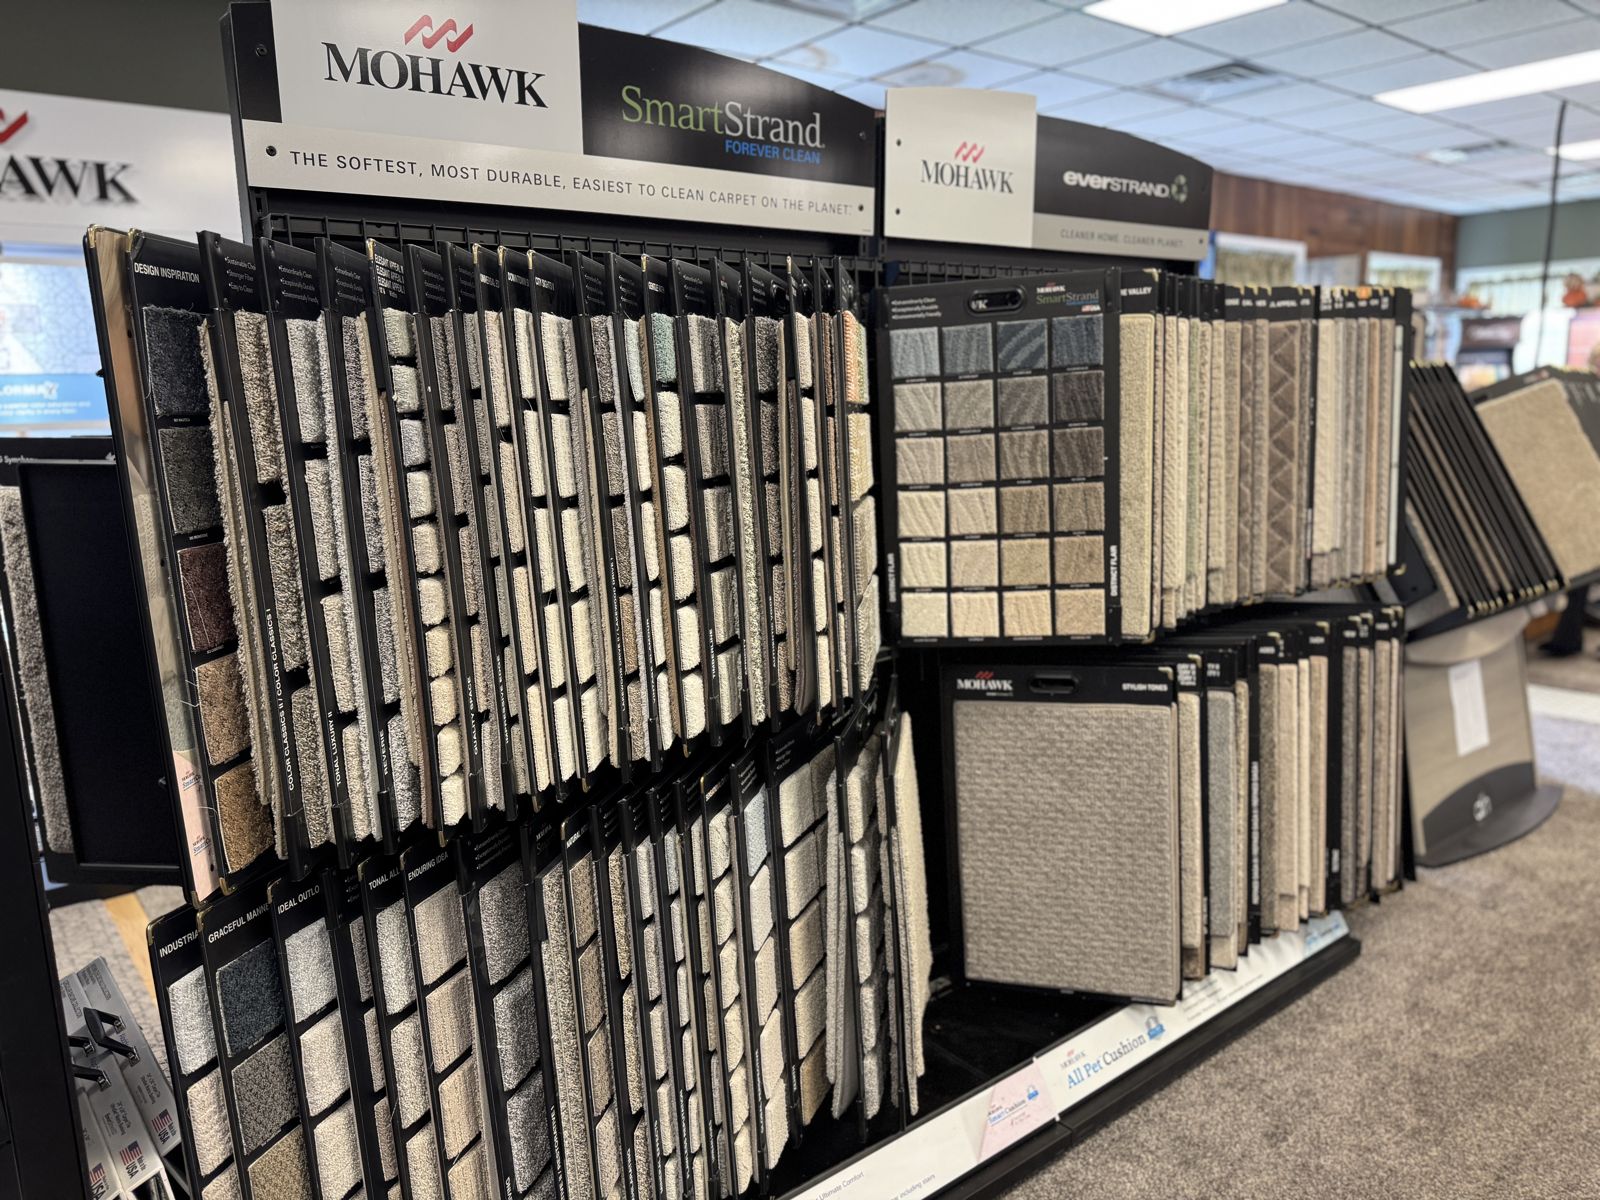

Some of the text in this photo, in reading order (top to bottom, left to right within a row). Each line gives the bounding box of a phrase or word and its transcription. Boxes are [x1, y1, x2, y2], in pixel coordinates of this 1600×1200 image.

[321, 41, 549, 108] MOHAWK
[621, 85, 823, 148] SmartStrand
[725, 139, 821, 165] FOREVER CLEAN
[0, 155, 139, 202] AWK
[290, 150, 328, 168] THE
[336, 154, 424, 178] SOFTEST,
[430, 163, 481, 181] MOST
[486, 168, 567, 190] DURABLE,
[572, 175, 632, 195] EASIEST
[638, 184, 656, 197] TO
[661, 186, 704, 202] CLEAN
[709, 191, 757, 207] CARPET
[761, 197, 778, 208] ON
[782, 198, 804, 212] THE
[921, 159, 1014, 195] MOHAWK
[1063, 170, 1170, 199] everSTRAND
[134, 262, 200, 283] DESIGN INSPIRATION
[887, 553, 895, 574] FLAIR
[1110, 568, 1118, 597] DISTINCT
[266, 613, 277, 661] CLASSICS
[271, 663, 283, 697] COLOR
[957, 679, 1013, 690] MOHAWK
[1122, 683, 1168, 692] STYLISH TONES
[279, 710, 290, 757] CLASSICS
[328, 719, 338, 757] LUXURY
[380, 730, 388, 775] REVERIE
[283, 758, 294, 791] COLOR
[332, 758, 341, 786] TONAL
[407, 851, 449, 882] ENDURING IDEA
[369, 874, 389, 891] TONAL
[277, 884, 320, 915] IDEAL OUTLO
[159, 929, 199, 958] INDUSTRIA
[208, 919, 246, 944] GRACEFUL
[1067, 1033, 1147, 1089] All Pet Cushion
[157, 1128, 171, 1145] USA
[124, 1161, 139, 1179] USA
[819, 1171, 864, 1200] Ultimate Comfort
[900, 1173, 936, 1199] including stairs
